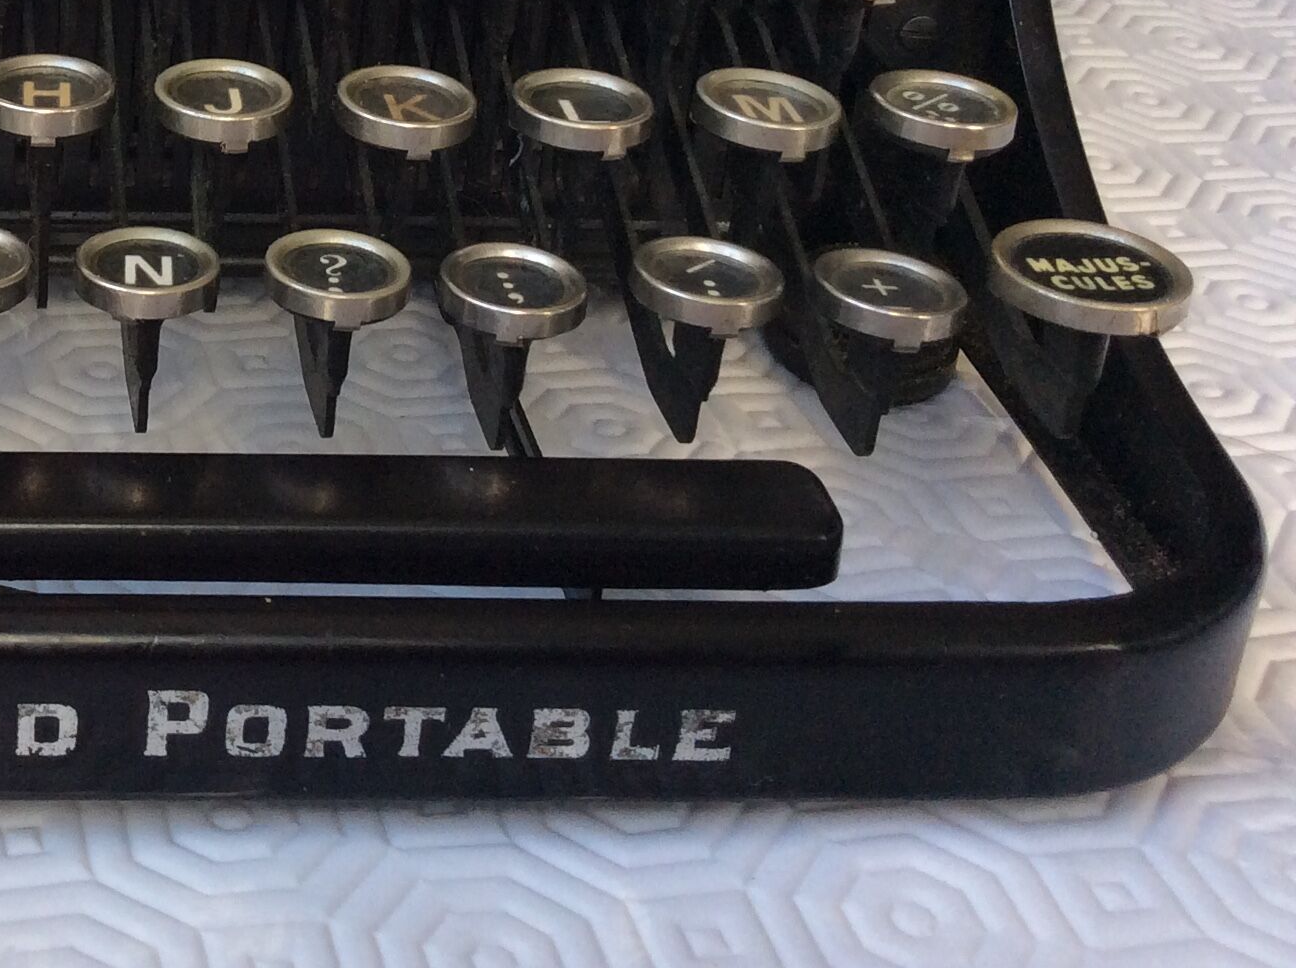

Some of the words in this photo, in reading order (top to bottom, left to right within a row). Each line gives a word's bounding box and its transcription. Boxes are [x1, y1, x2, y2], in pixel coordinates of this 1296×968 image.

[23, 82, 71, 108] H
[205, 88, 243, 115] J
[384, 93, 439, 121] K
[732, 94, 804, 122] M
[558, 99, 611, 123] L
[124, 254, 174, 286] N
[319, 254, 348, 284] ?
[1025, 257, 1151, 273] MAJUS-
[1050, 275, 1155, 290] CULES
[144, 689, 737, 762] PORTABLE
